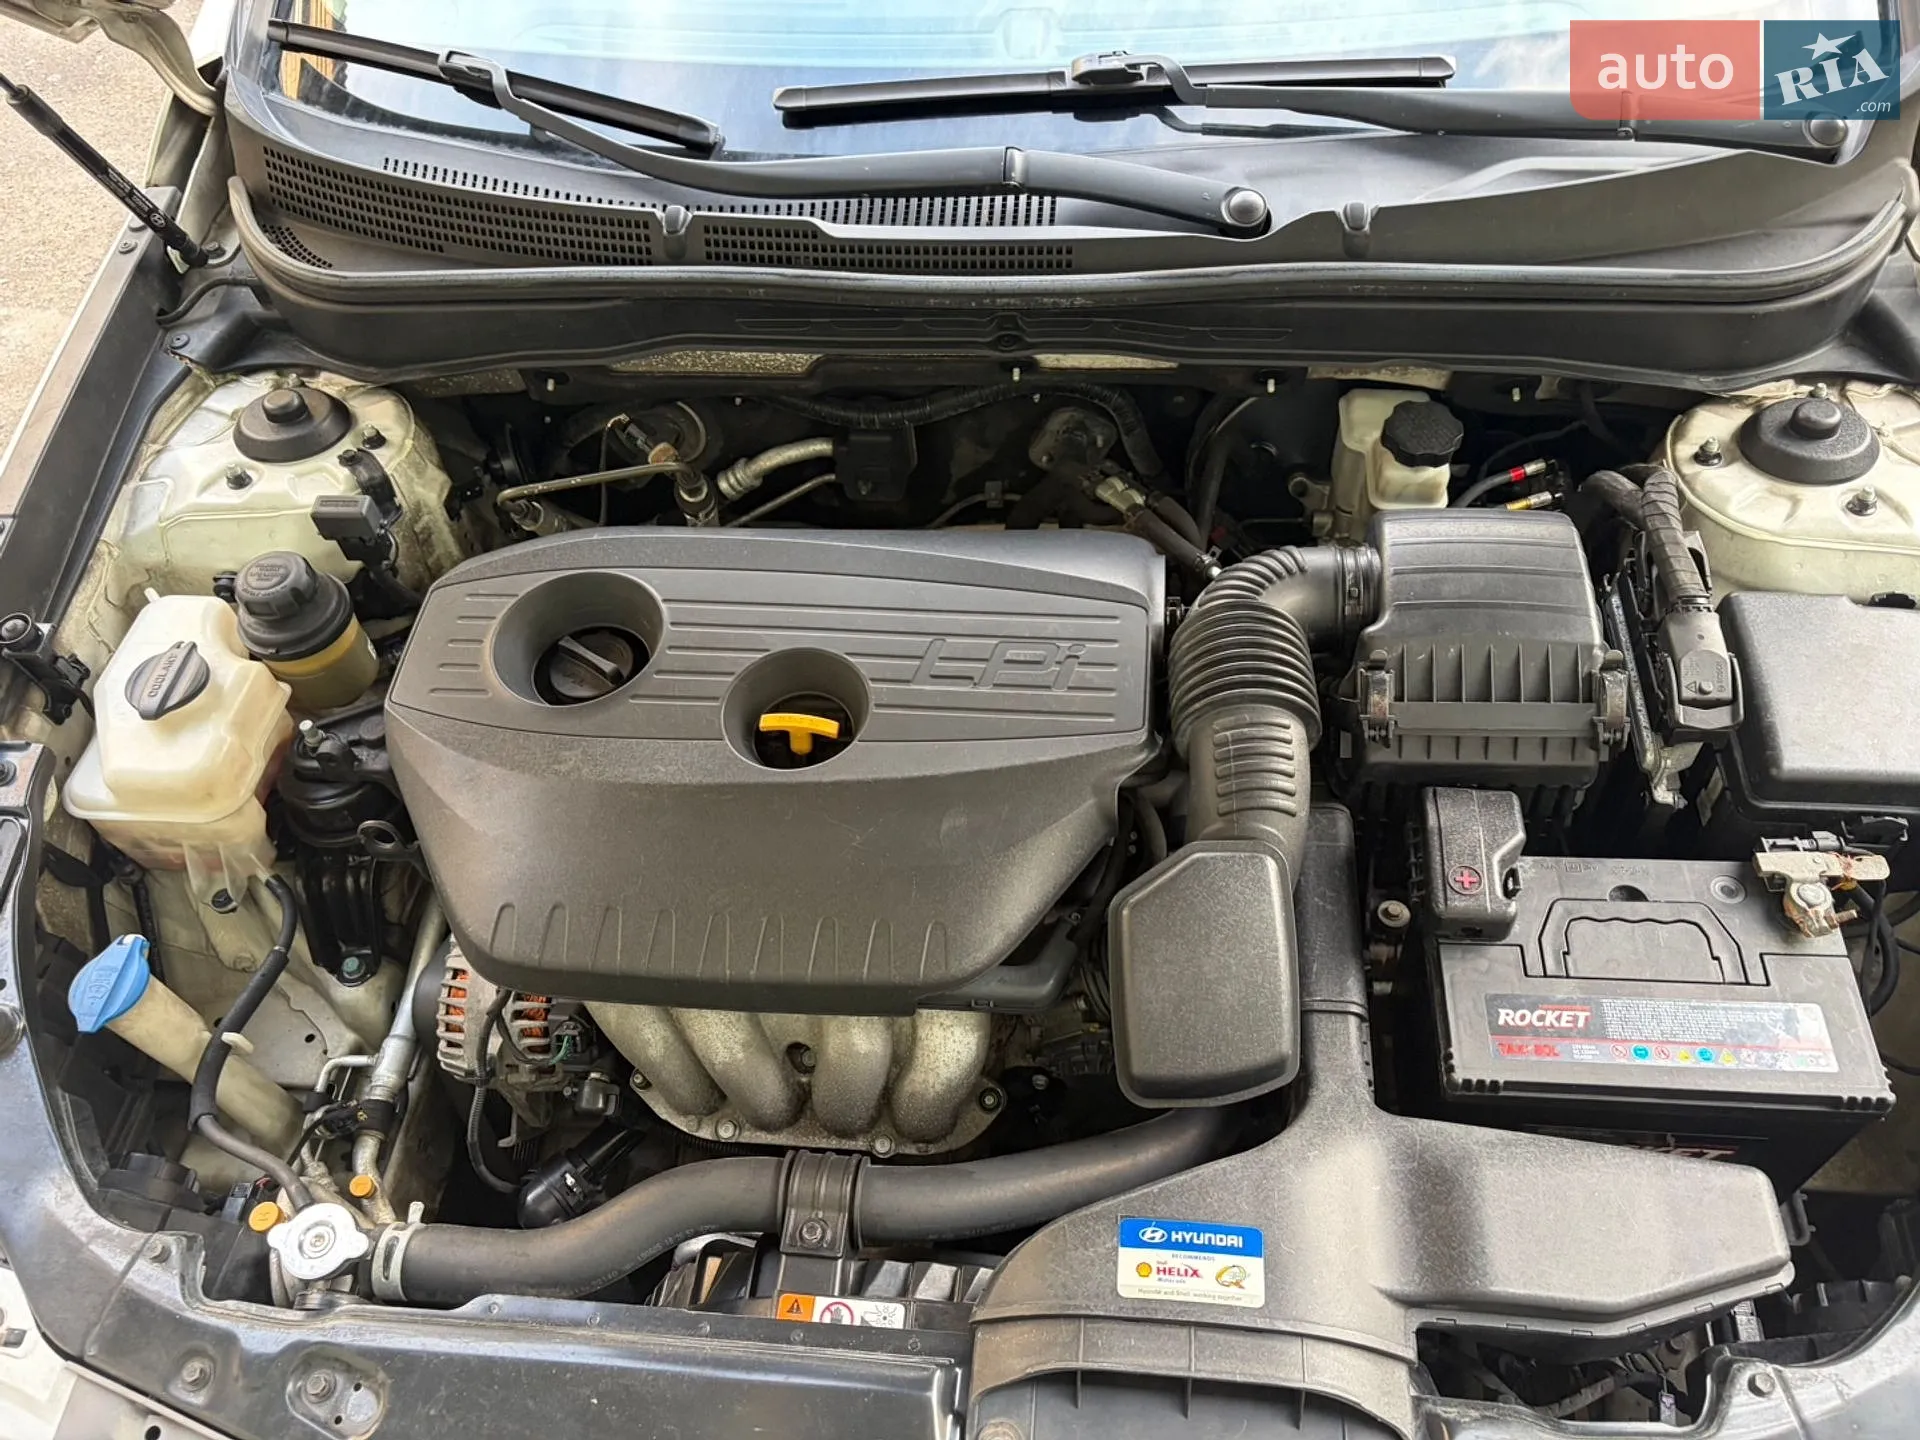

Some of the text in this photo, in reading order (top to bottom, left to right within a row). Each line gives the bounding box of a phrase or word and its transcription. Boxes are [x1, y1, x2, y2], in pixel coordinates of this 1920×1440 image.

[147, 653, 178, 697] COOLANT
[1498, 1008, 1591, 1028] ROCKET
[1171, 1230, 1243, 1248] HYUNDAI
[1156, 1266, 1203, 1278] HELIX
